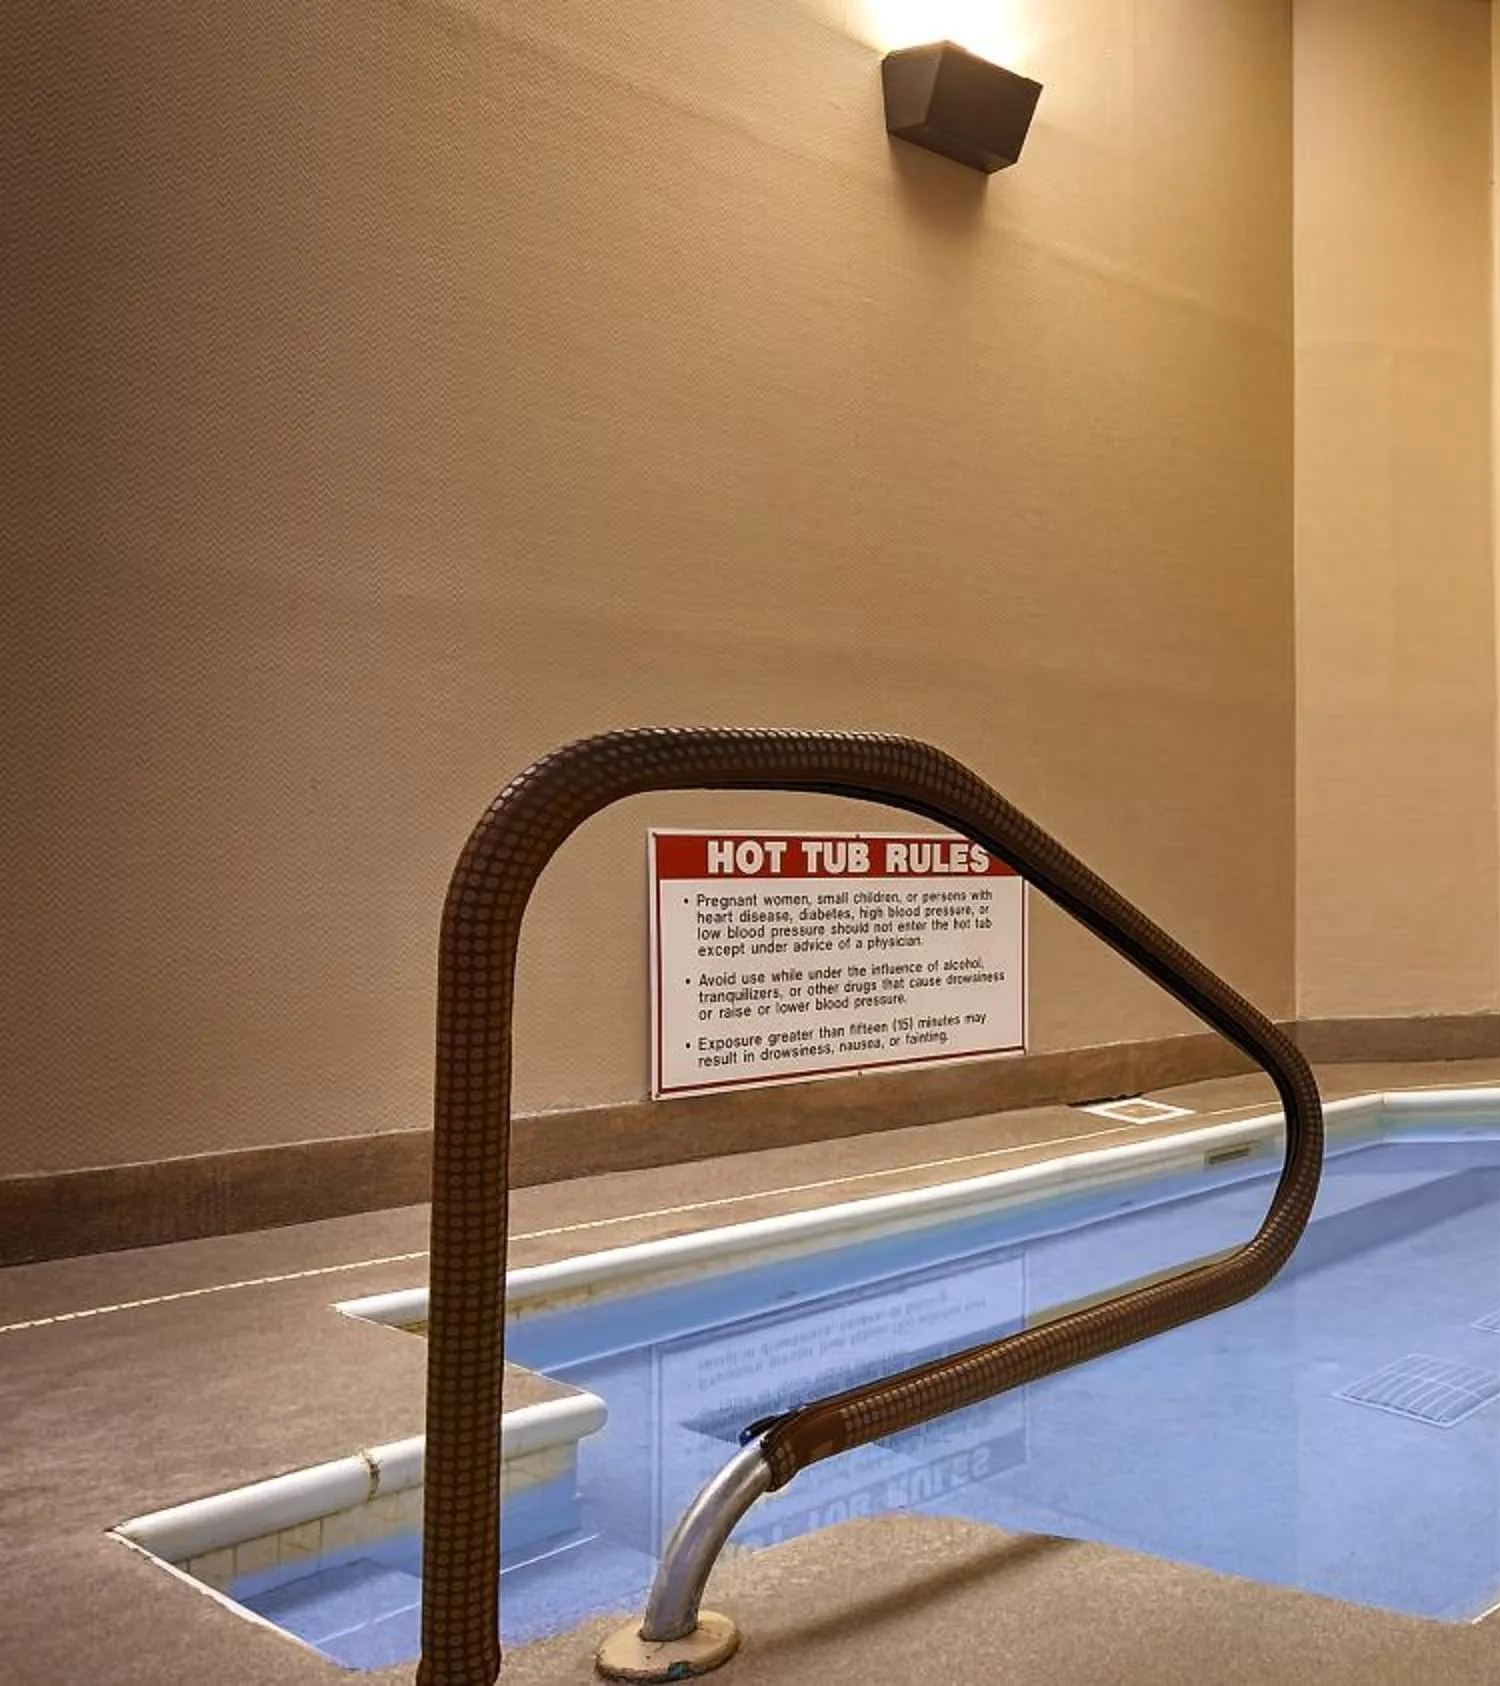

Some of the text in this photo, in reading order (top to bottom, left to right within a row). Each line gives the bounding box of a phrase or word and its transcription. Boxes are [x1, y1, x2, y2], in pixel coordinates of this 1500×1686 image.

[707, 840, 990, 873] HOT TUB RULES
[697, 893, 757, 910] Pregnant
[817, 892, 848, 904] small
[906, 893, 918, 902] or
[922, 891, 966, 904] persons
[971, 890, 992, 901] with
[698, 905, 989, 924] heart disease, diabetes, high blood pressure, or
[698, 918, 992, 940] low blood pressure should not enter the hot tub
[698, 942, 745, 958] except
[752, 939, 788, 954] under
[794, 939, 832, 952] advice
[838, 939, 850, 949] of
[856, 939, 862, 949] a
[699, 972, 736, 986] Avoid
[742, 973, 765, 984] use
[772, 968, 803, 982] while
[808, 966, 842, 980] under
[848, 965, 866, 976] the
[871, 963, 922, 975] influence
[928, 960, 939, 972] of
[789, 988, 802, 996] or
[808, 983, 838, 996] other
[844, 981, 877, 994] drugs
[882, 978, 904, 989] that
[909, 976, 941, 988] cause
[946, 971, 1005, 985] drowsiness
[698, 1010, 712, 1020] or
[719, 1006, 752, 1018] raise
[758, 1005, 770, 1016] or
[776, 1002, 810, 1013] lower
[815, 997, 848, 1010] blood
[698, 1013, 987, 1052] Exposure greater than fifteen (15) minutes may
[698, 1052, 737, 1067] result
[744, 1050, 754, 1062] in
[760, 1044, 835, 1060] drowsiness,
[839, 1038, 884, 1052] nausea,
[889, 1037, 900, 1047] or
